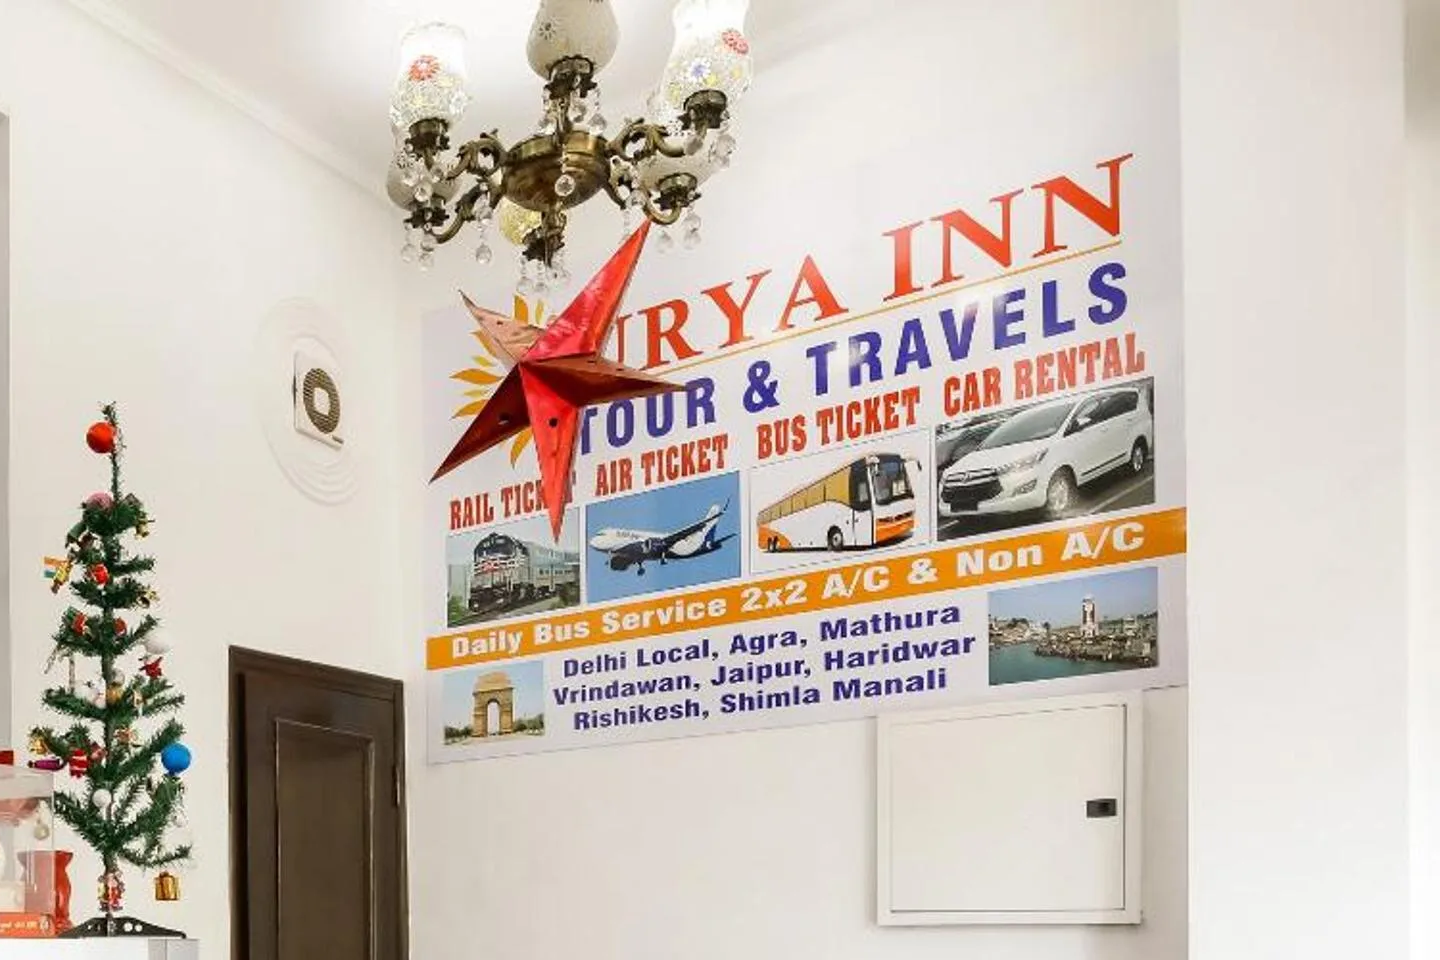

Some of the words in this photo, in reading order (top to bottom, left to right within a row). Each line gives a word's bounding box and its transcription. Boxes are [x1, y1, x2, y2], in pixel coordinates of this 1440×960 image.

[616, 253, 849, 373] RYA
[882, 152, 1134, 301] INN
[580, 377, 716, 455] TOUR
[743, 360, 780, 413] &
[806, 262, 1129, 397] TRAVELS
[943, 367, 1003, 416] CAR
[1013, 332, 1145, 400] RENTAL
[757, 415, 807, 460] BUS
[816, 386, 921, 446] TICKET
[595, 453, 634, 497] AIR
[641, 433, 728, 487] TICKET
[449, 492, 494, 530] RAIL
[452, 628, 522, 659] Daily
[533, 617, 590, 645] Bus
[601, 596, 727, 635] Service
[741, 580, 808, 612] 2x2
[821, 564, 890, 599] A/C
[906, 556, 938, 585] &
[956, 544, 1044, 578] Non
[1061, 522, 1145, 560] A/C
[552, 675, 701, 705] Vrindawan,
[711, 656, 812, 687] Jaipur,
[824, 634, 976, 672] Haridwar
[563, 650, 627, 678] Delhi
[636, 638, 719, 668] Local,
[730, 628, 807, 657] Agra,
[819, 604, 960, 641] Mathura
[573, 699, 710, 731] Rishikesh,
[720, 684, 821, 714] Shimla
[832, 667, 947, 701] Manali
